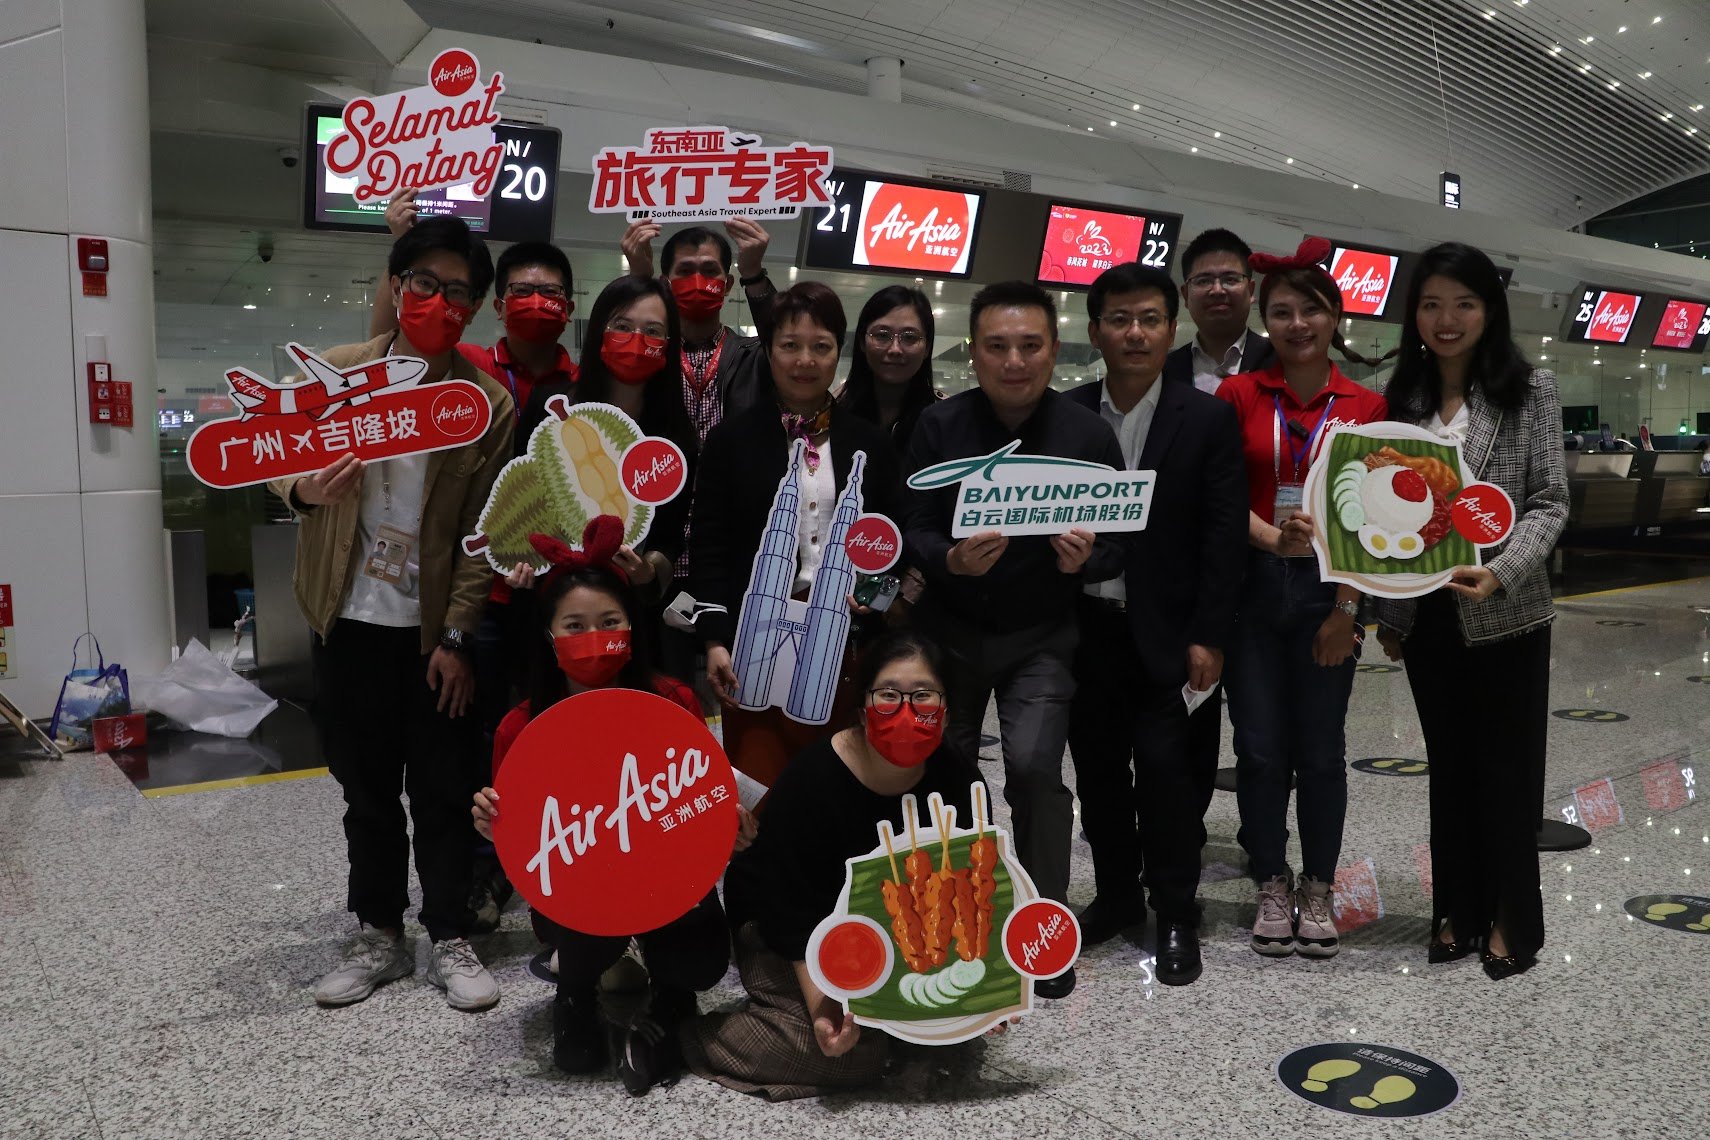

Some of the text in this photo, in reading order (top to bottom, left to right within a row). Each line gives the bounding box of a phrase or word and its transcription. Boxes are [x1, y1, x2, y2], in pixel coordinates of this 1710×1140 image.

[327, 74, 501, 174] Selamat
[650, 130, 725, 154] 东南亚
[355, 138, 503, 201] Datang
[500, 164, 547, 202] 20
[594, 147, 830, 208] 旅行专家
[651, 206, 777, 218] Southeast Asia Travel Expert
[816, 203, 850, 233] 21
[869, 202, 962, 252] AirAsia
[1149, 221, 1165, 236] N/
[1141, 239, 1169, 267] 22
[1335, 263, 1385, 299] AirAsia
[1575, 302, 1594, 322] 25
[1592, 302, 1630, 330] AirAsia
[232, 375, 267, 400] AirAsia
[436, 403, 473, 424] AirAsia
[219, 406, 421, 471] 广州 吉隆坡
[631, 453, 675, 495] AirAsia
[963, 481, 1149, 504] BAIYUNPORT
[960, 503, 1144, 527] 白云国际机场股份
[1455, 497, 1503, 533] AirAsia
[848, 531, 895, 553] AirAsia
[525, 747, 710, 897] AirAsia
[658, 784, 730, 833] 亚洲航空
[1021, 913, 1062, 970] AirAsia
